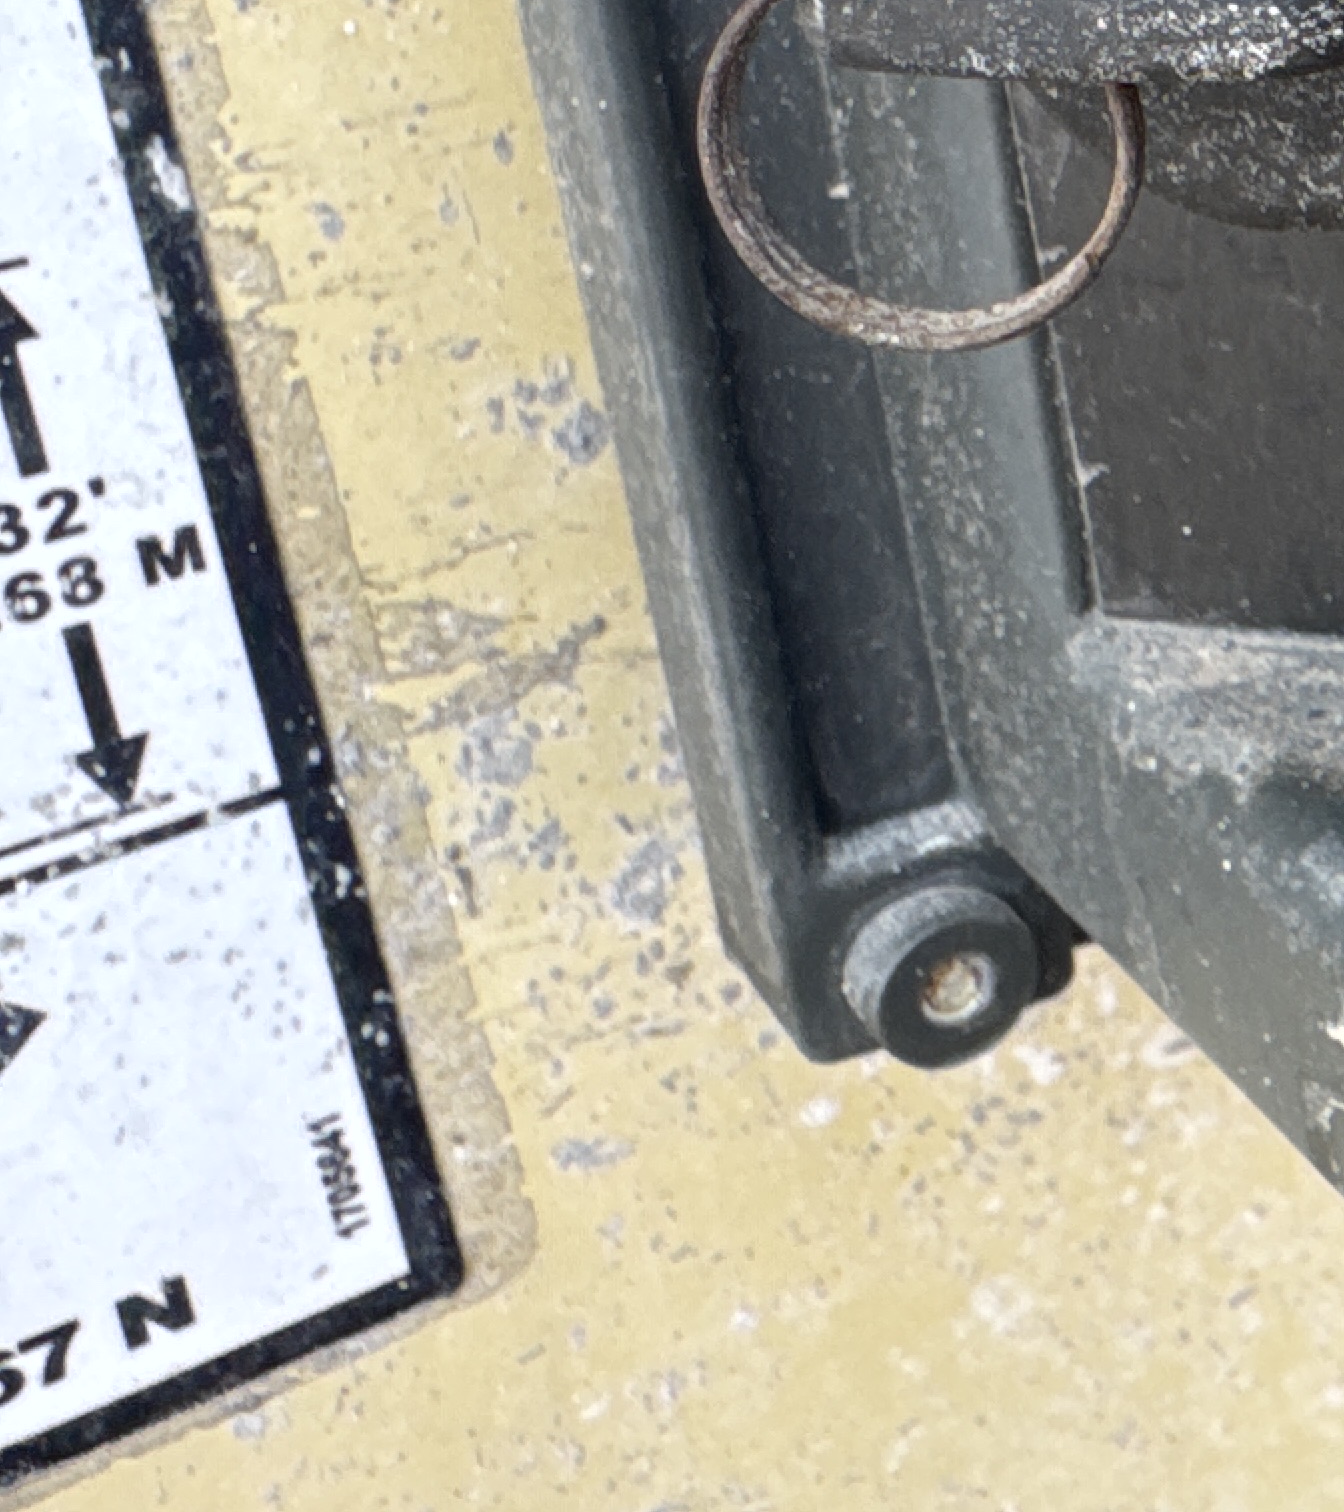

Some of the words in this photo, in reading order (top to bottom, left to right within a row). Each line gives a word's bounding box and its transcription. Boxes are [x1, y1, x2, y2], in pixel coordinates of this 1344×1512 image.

[0, 556, 105, 630] 68
[135, 523, 207, 588] M
[115, 1273, 196, 1351] N
